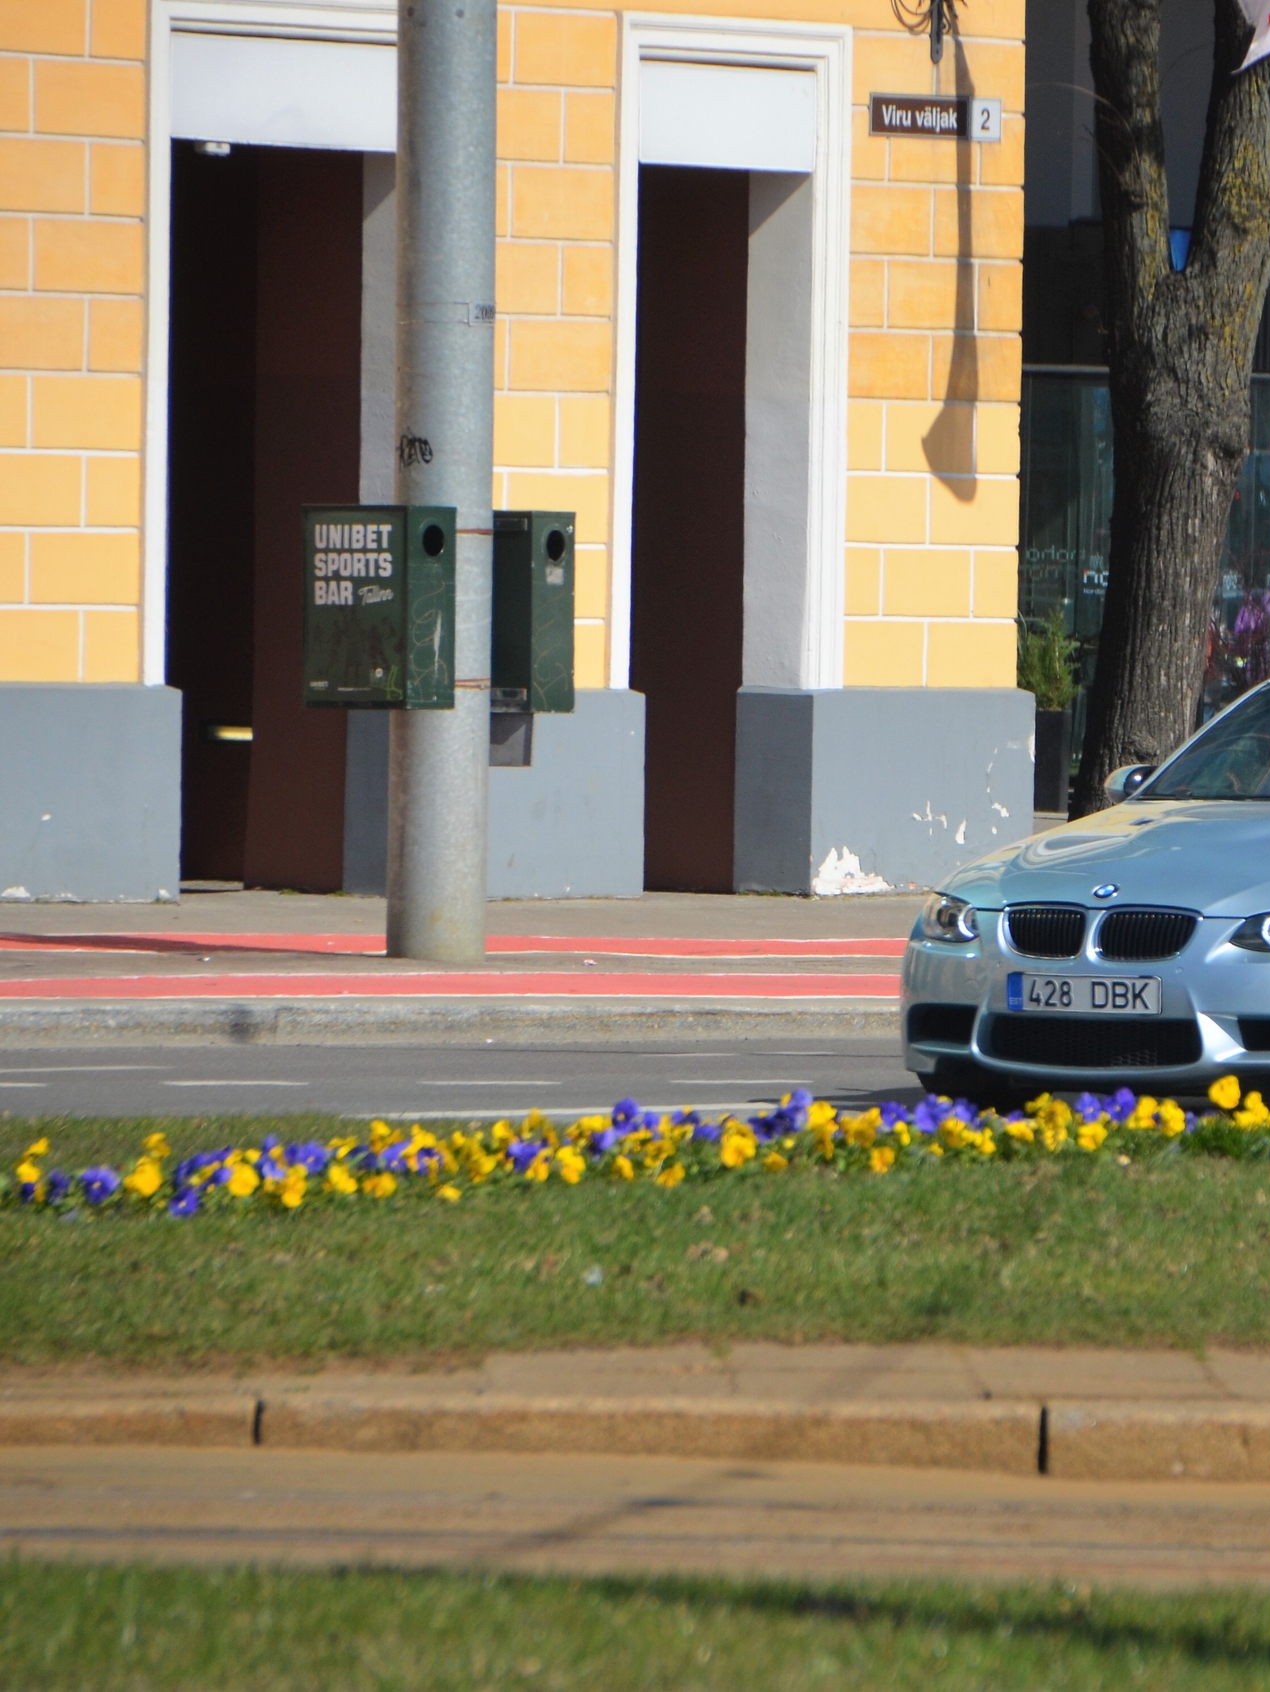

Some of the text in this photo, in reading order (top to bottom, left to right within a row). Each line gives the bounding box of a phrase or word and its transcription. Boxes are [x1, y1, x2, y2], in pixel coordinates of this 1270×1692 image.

[882, 105, 958, 133] Viru väljak
[981, 107, 991, 131] 2
[314, 524, 392, 549] UNIBET
[313, 552, 393, 577] SPORTS
[314, 580, 394, 606] BAR Tallinn
[1009, 997, 1022, 1005] EST
[1029, 979, 1151, 1009] 428 DBK
